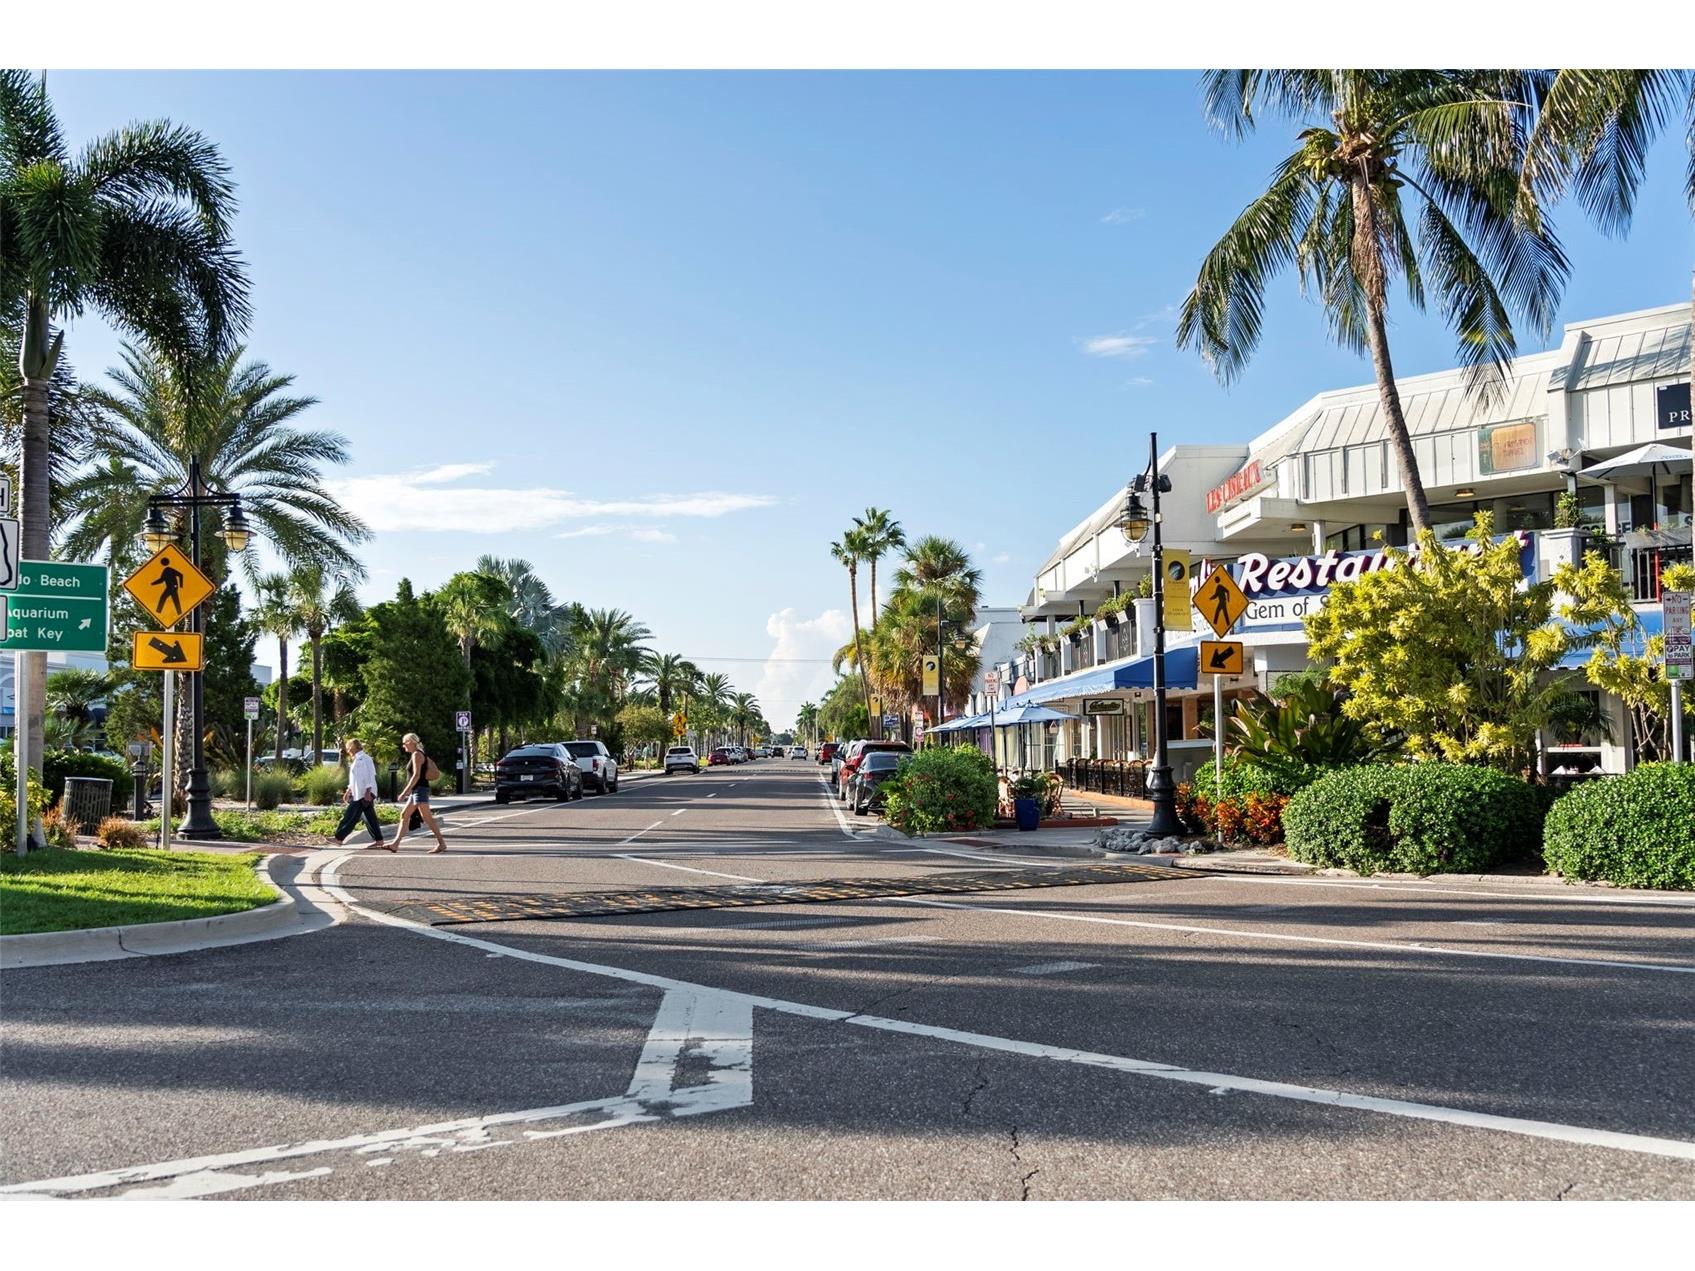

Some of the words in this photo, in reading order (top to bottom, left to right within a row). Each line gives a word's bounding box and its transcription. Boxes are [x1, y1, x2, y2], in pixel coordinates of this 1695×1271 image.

[40, 574, 80, 587] Beach
[1245, 601, 1285, 620] Gem
[1292, 596, 1310, 616] of
[37, 627, 63, 641] Key
